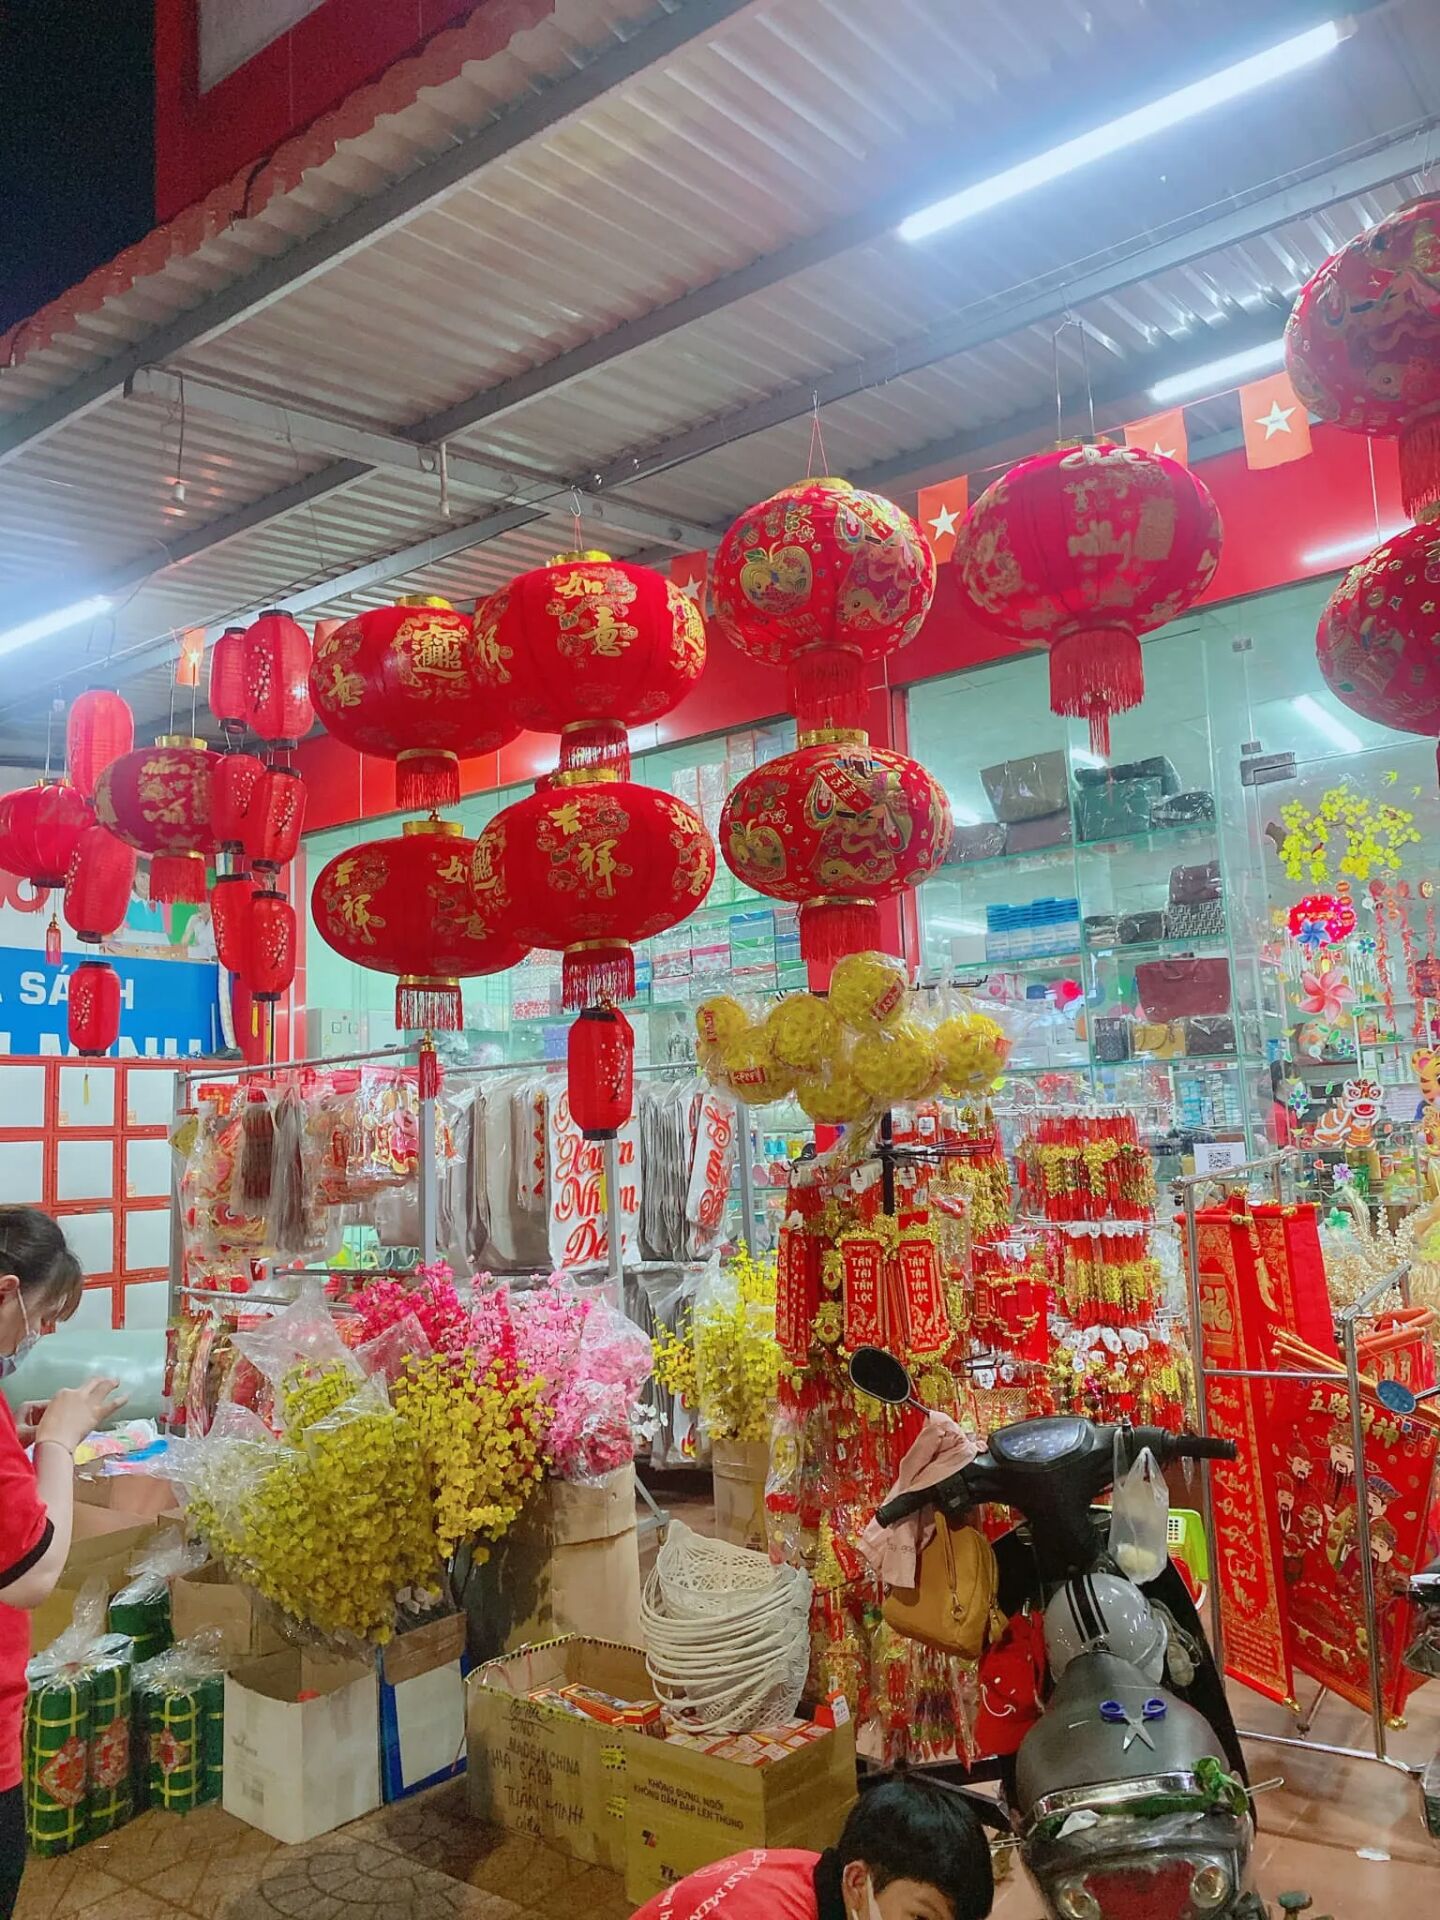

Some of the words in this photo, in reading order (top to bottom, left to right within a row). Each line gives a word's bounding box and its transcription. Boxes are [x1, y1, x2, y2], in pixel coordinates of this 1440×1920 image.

[20, 965, 135, 1010] SÁH
[555, 1134, 635, 1181] Xun
[555, 1171, 639, 1222] Nhm
[549, 1752, 580, 1776] CHINA
